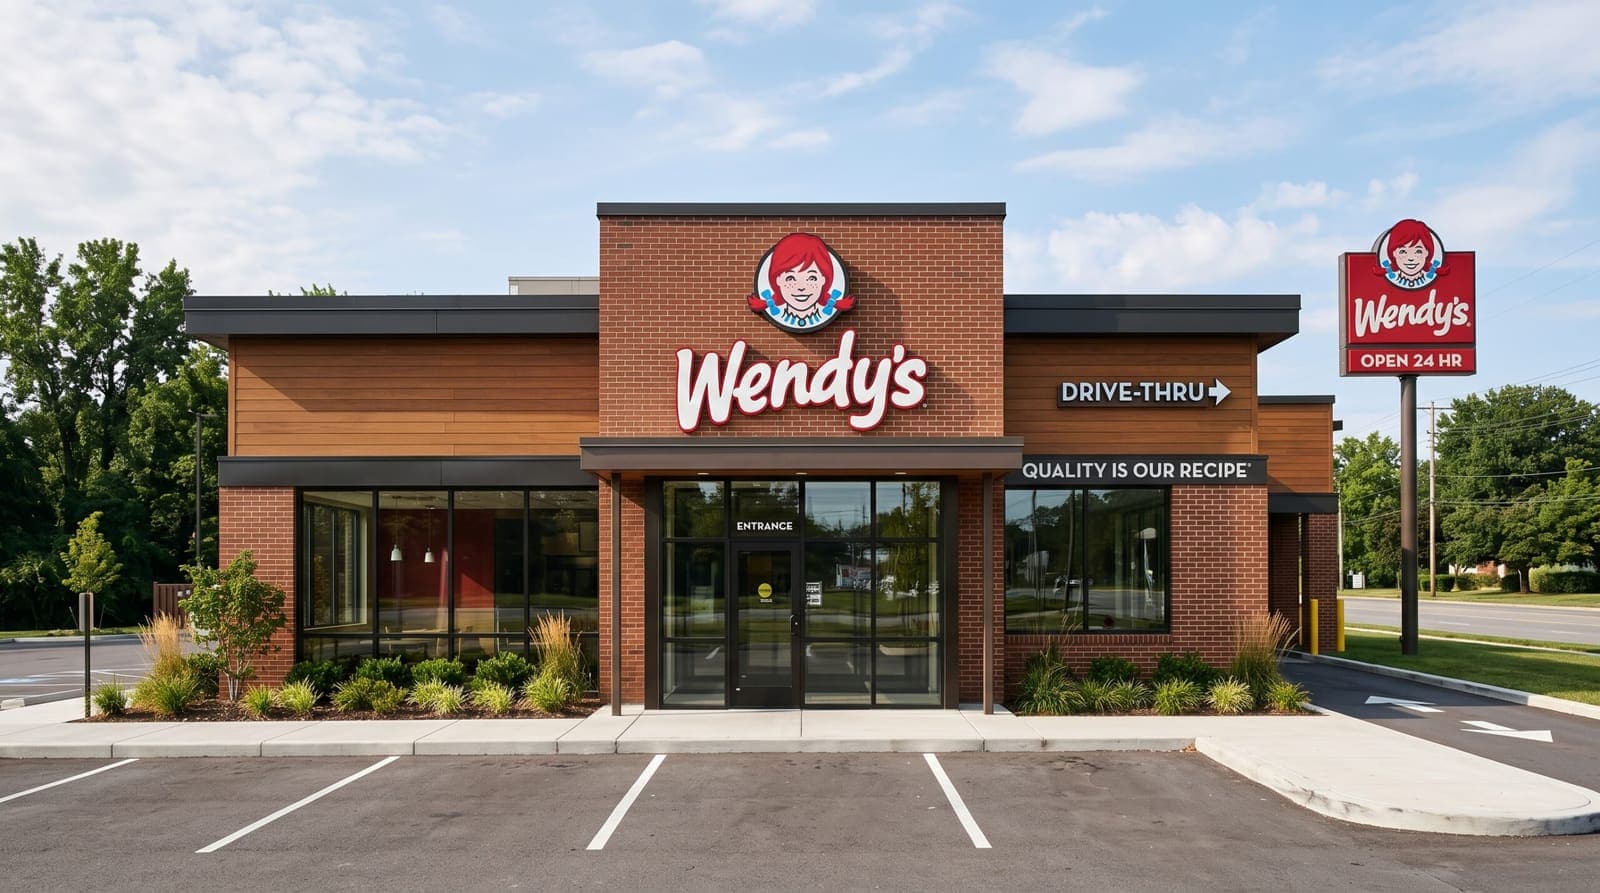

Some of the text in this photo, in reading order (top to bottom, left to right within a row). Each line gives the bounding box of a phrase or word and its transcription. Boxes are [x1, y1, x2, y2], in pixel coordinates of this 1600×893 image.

[1355, 289, 1469, 337] Wendy's
[1360, 353, 1462, 367] OPEN 24 HR
[676, 329, 927, 431] Wendy's
[1061, 382, 1204, 401] DRIVE-THRU
[1022, 462, 1107, 479] QUALITY
[1112, 462, 1128, 478] IS
[1133, 462, 1175, 478] OUR
[736, 521, 793, 531] ENTRANCE
